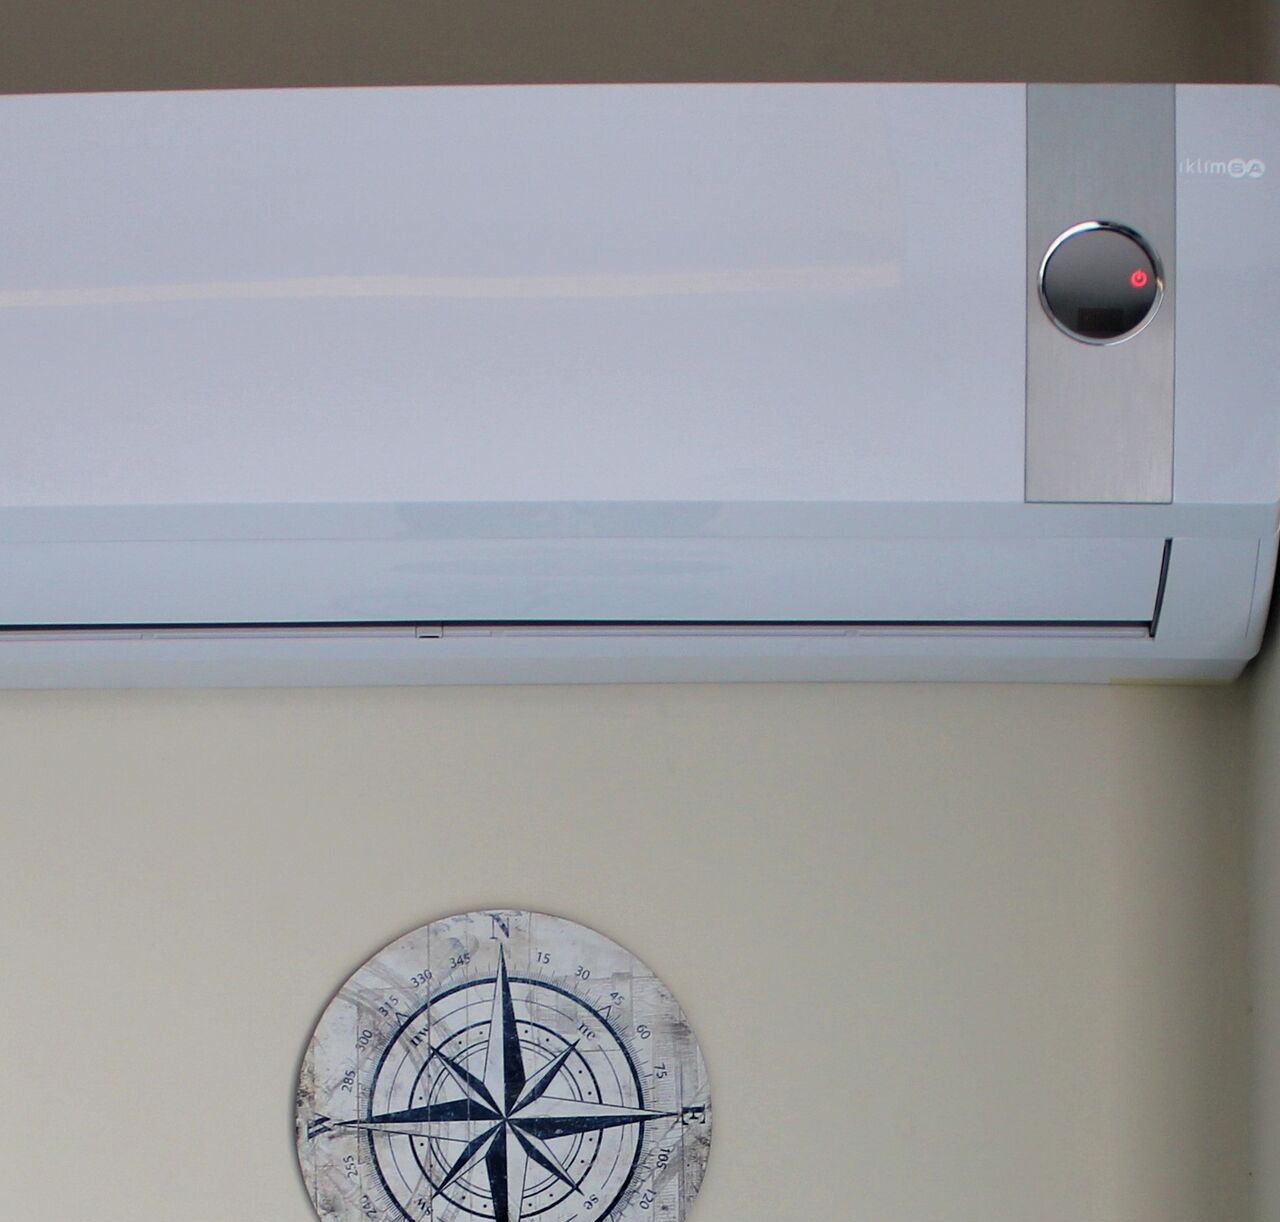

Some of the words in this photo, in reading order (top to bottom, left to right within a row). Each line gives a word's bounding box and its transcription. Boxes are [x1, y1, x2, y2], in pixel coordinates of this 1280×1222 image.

[449, 953, 471, 970] 345
[536, 951, 552, 965] 15
[410, 968, 434, 990] 330
[575, 965, 591, 982] 30
[378, 996, 400, 1017] 315
[610, 990, 626, 1008] 45
[635, 1024, 652, 1041] 60
[653, 1063, 669, 1080] 75
[341, 1069, 357, 1094] 285
[342, 1155, 359, 1178] 255
[656, 1148, 672, 1170] 105
[639, 1188, 658, 1211] 120
